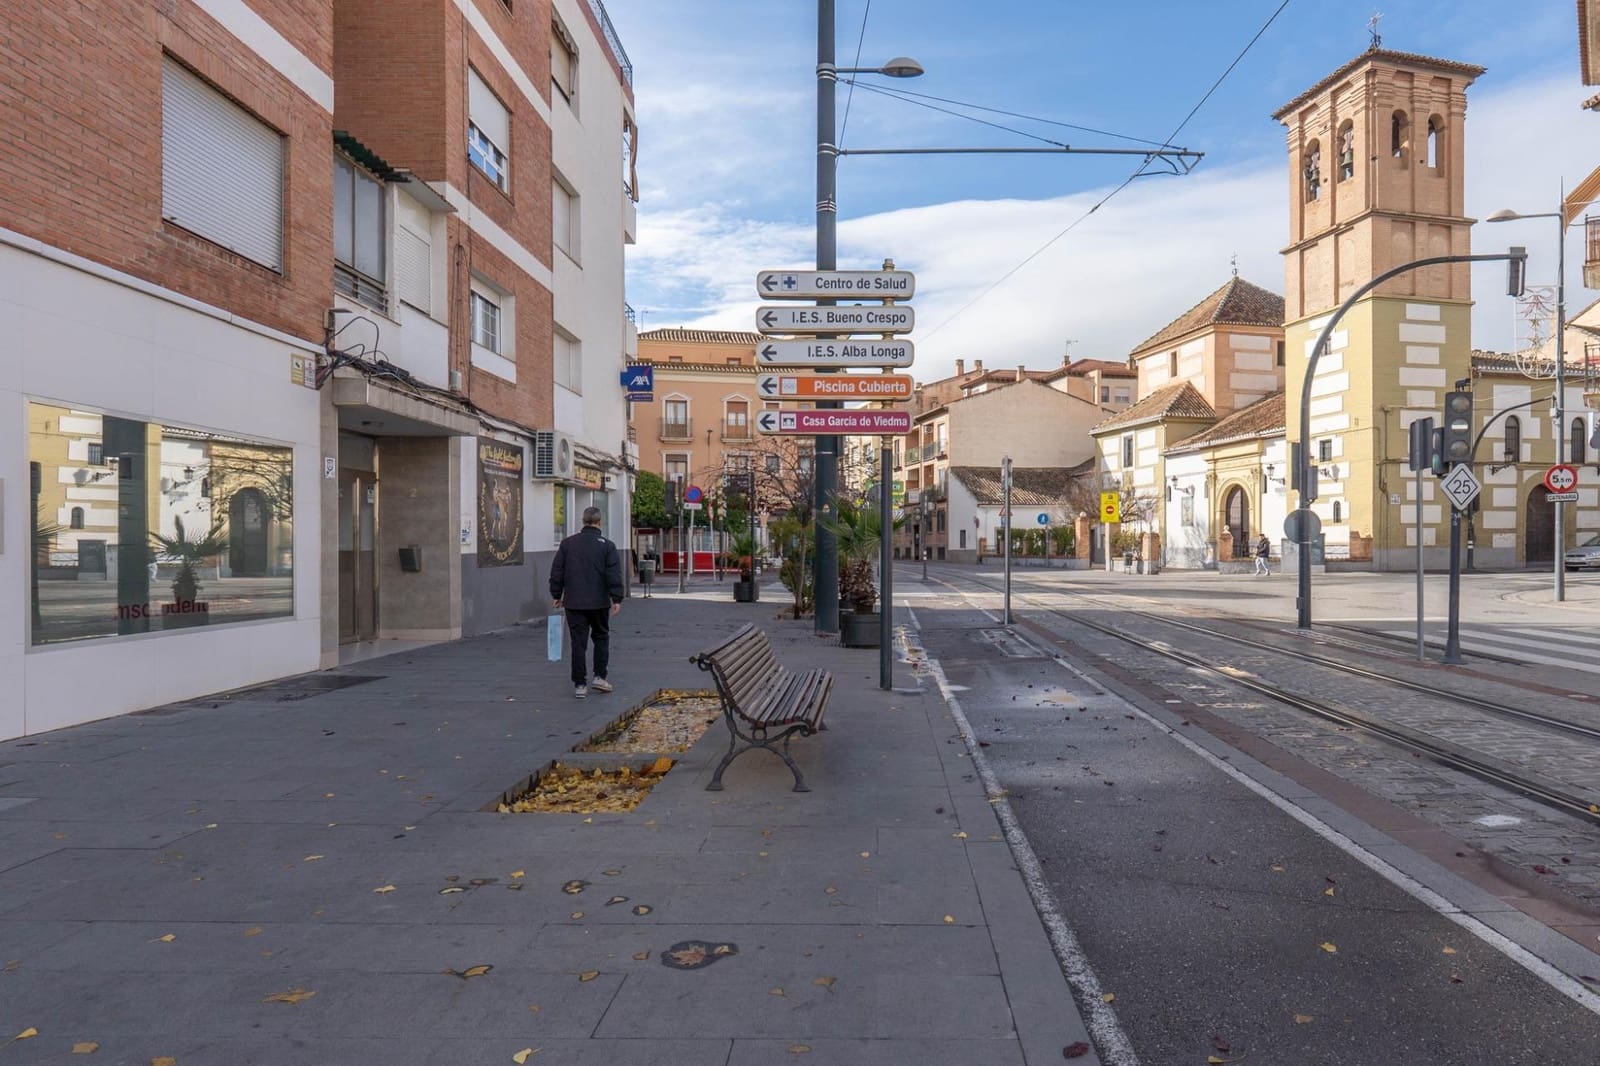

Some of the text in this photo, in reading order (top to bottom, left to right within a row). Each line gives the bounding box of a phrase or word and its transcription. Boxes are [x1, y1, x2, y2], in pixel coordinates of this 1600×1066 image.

[815, 277, 907, 289] Centro de Salud
[792, 311, 907, 326] I.E.S. Bueno Crespo
[807, 345, 905, 359] I.E.S. Alba Longa
[630, 375, 651, 386] AXA
[813, 380, 907, 393] Piscina Cubierta
[802, 416, 825, 426] Casa
[859, 416, 871, 426] de
[873, 415, 908, 426] Viedma
[1453, 479, 1471, 494] 25
[409, 488, 417, 498] 2
